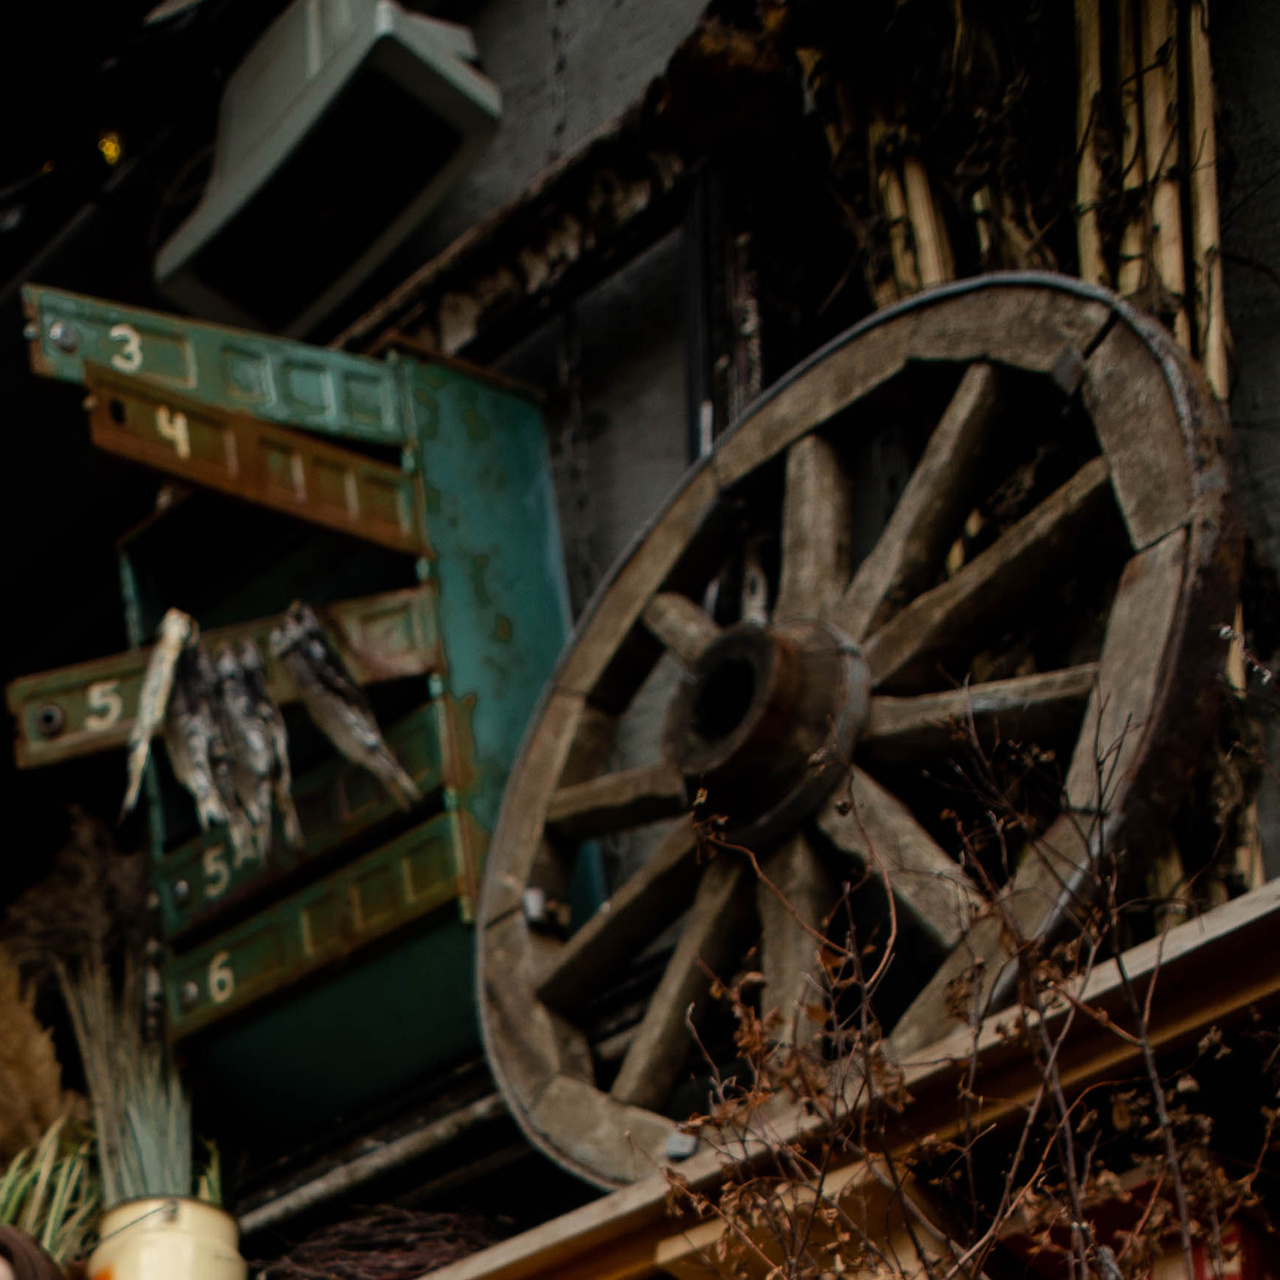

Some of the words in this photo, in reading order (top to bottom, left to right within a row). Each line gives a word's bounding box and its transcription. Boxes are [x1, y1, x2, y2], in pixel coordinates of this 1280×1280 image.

[109, 323, 143, 374] 3
[155, 404, 191, 460] 4
[85, 680, 123, 733] 5
[202, 842, 231, 898] 5
[208, 949, 234, 1004] 6
